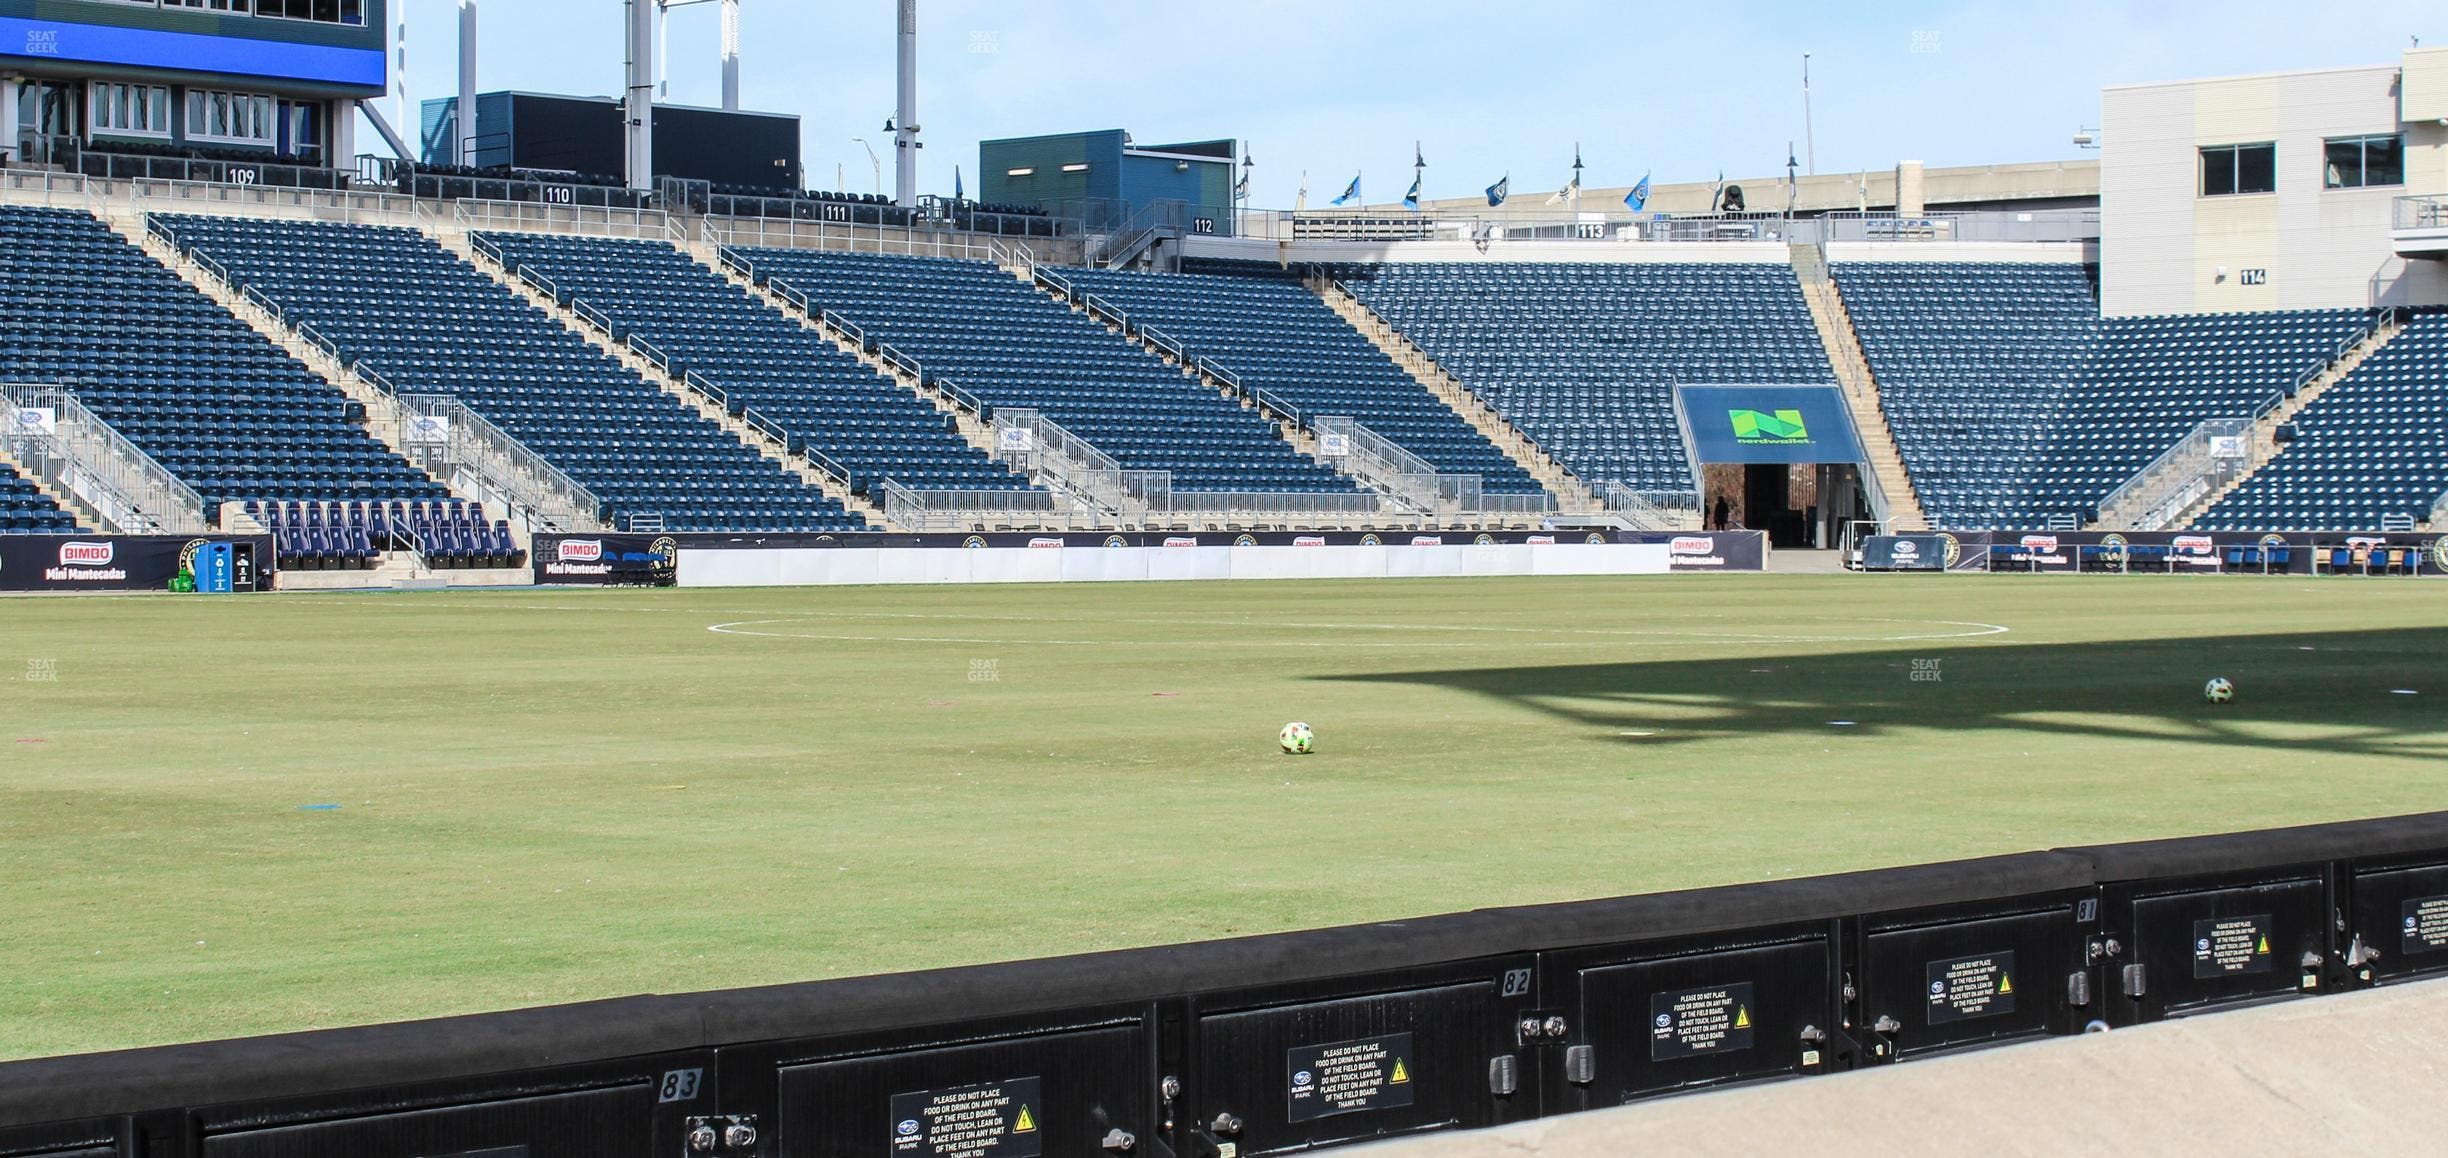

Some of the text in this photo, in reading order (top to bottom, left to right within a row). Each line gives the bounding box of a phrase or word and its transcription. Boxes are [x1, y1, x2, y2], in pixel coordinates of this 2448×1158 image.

[230, 168, 255, 184] 109
[547, 187, 569, 203] 110
[826, 205, 845, 221] 111
[1195, 219, 1212, 233] 112
[1580, 224, 1604, 238] 113
[2242, 270, 2265, 284] 114
[65, 547, 110, 559] BIMBO
[562, 544, 599, 556] BIMBO
[1674, 541, 1710, 550] BIMBO
[46, 566, 127, 580] Mini Mantecadas
[546, 562, 564, 574] Mini
[2079, 901, 2095, 920] 81
[1505, 971, 1528, 994] 82
[1324, 1043, 1379, 1058] PLEASE DO NOT PLACE
[1316, 1059, 1329, 1067] FOOD
[1338, 1056, 1354, 1064] DRINK
[1363, 1053, 1373, 1061] ANY
[1374, 1051, 1387, 1059] PART
[1330, 1075, 1340, 1083] NOT
[1360, 1070, 1373, 1079] LEAN
[1374, 1069, 1381, 1077] OR
[1333, 1066, 1342, 1074] THE
[1343, 1064, 1358, 1072] FIELD
[663, 1070, 697, 1099] 83
[1320, 1085, 1336, 1094] PLACE
[1337, 1083, 1350, 1091] FEET
[1359, 1080, 1369, 1088] ANY
[1370, 1078, 1383, 1086] PART
[934, 1089, 1000, 1105] PLEASE DO NOT PLACE
[1325, 1094, 1333, 1102] OF
[1333, 1093, 1343, 1101] THE
[1344, 1090, 1358, 1099] FIELD
[1338, 1098, 1366, 1109] THANK YOU
[924, 1097, 1010, 1115] FOOD OR DRINK ON ANY PART
[935, 1108, 997, 1124] OF THE FIELD BOARD.
[931, 1117, 1003, 1134] DO NOT TOUCH, LEAN OR
[895, 1134, 922, 1144] SUBARU
[929, 1127, 1005, 1144] PLACE FEET ON ANY PART
[936, 1137, 999, 1153] OF THE FIELD BOARD.
[973, 1148, 985, 1157] YOU
